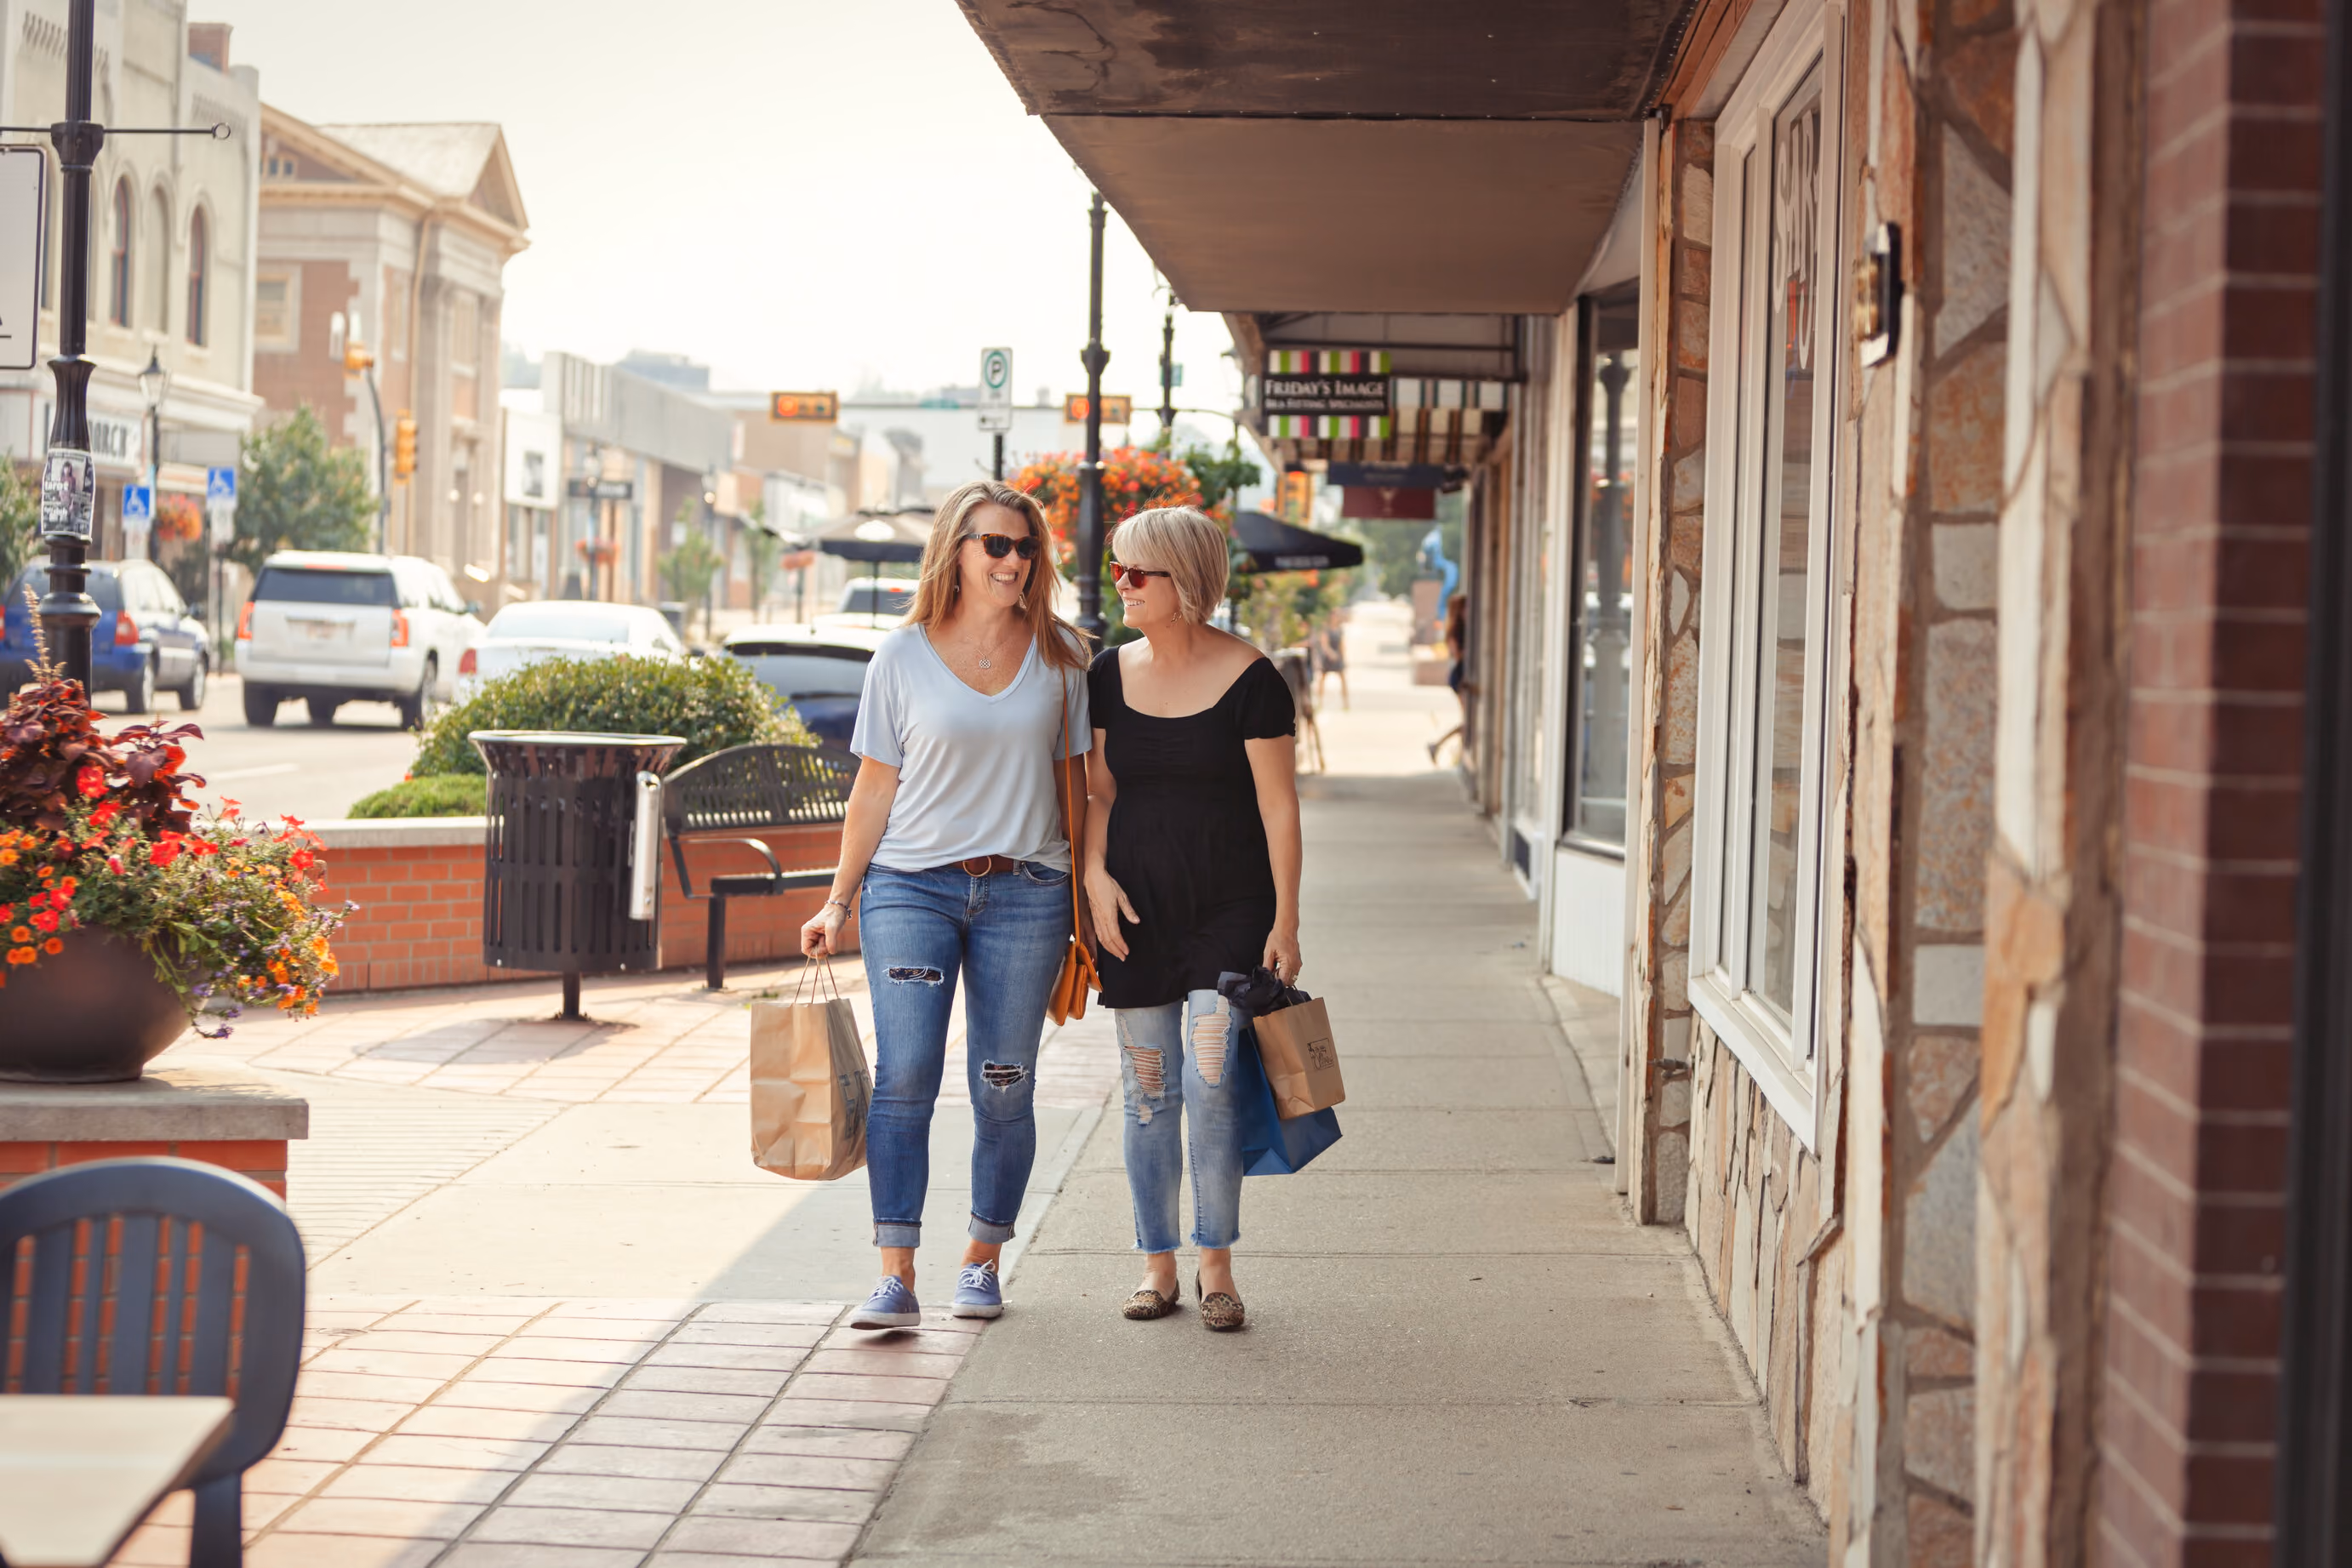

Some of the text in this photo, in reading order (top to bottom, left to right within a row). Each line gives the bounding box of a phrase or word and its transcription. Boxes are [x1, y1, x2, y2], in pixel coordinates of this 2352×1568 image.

[991, 360, 1002, 380] P
[1265, 379, 1384, 396] FRIDAY'S IMAGE
